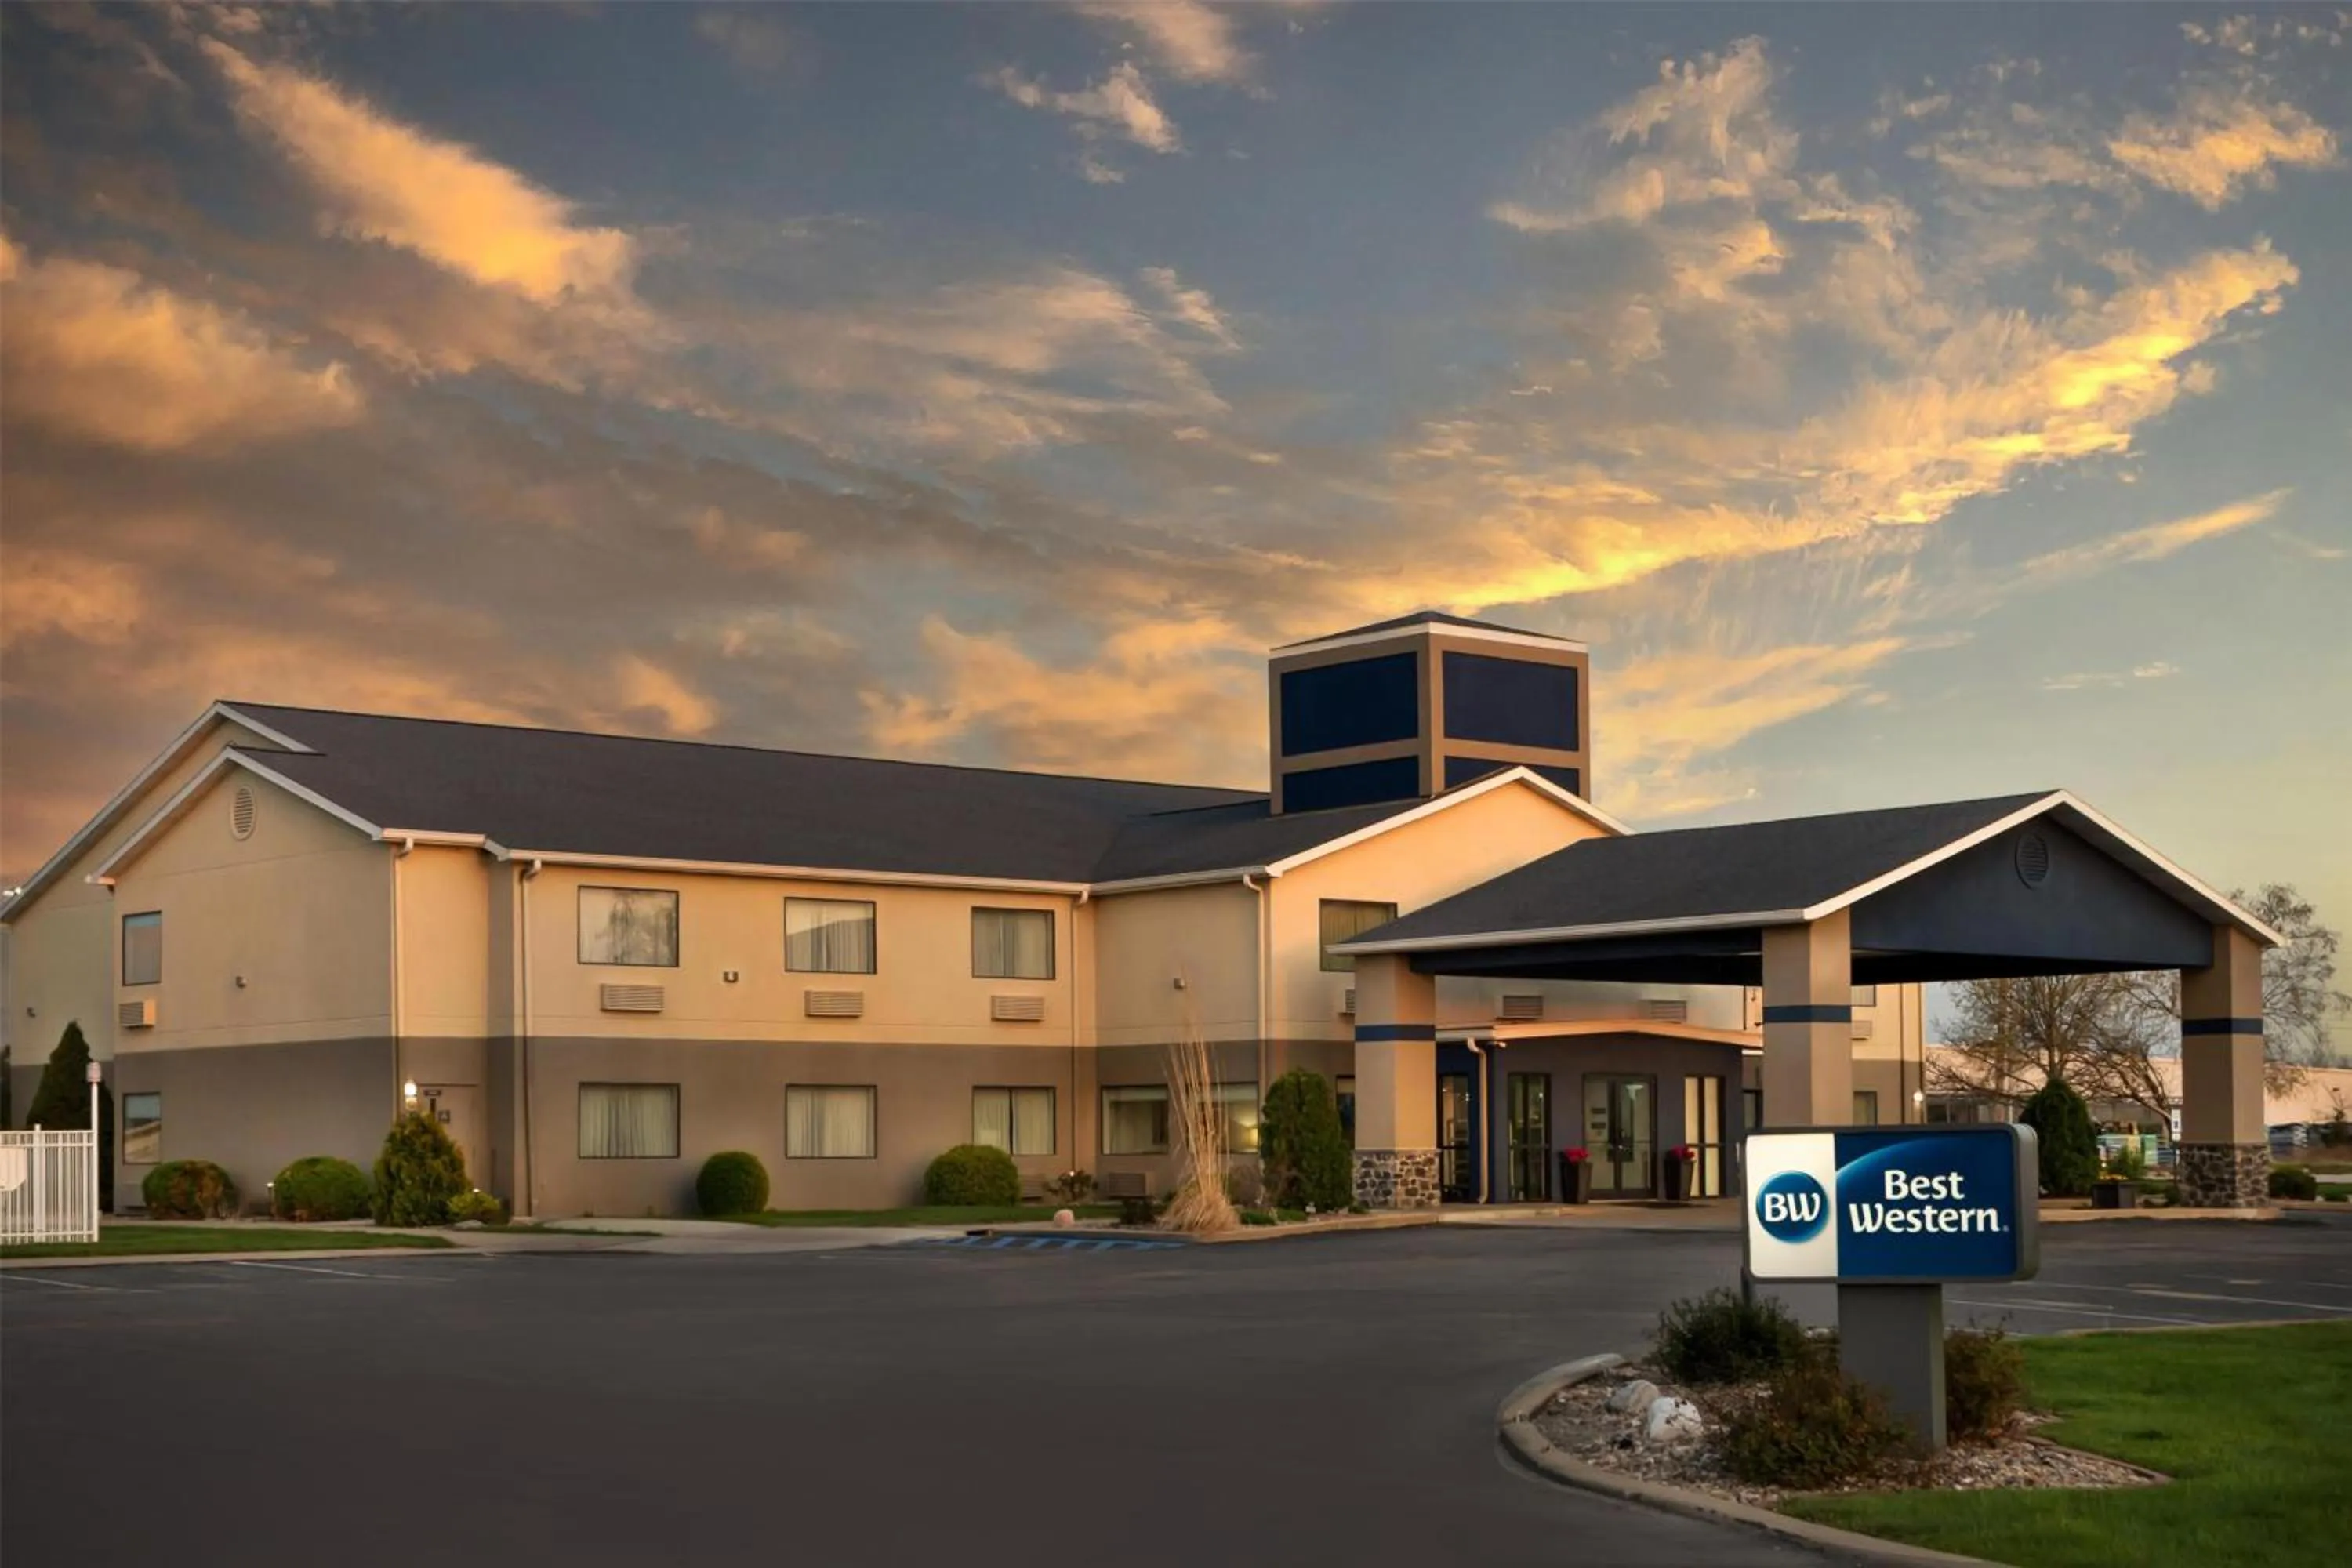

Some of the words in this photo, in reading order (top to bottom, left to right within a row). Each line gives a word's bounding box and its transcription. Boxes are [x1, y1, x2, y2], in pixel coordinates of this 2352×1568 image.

[1884, 1169, 1965, 1200] Best
[1764, 1192, 1821, 1223] BW
[1849, 1203, 2000, 1233] Western
